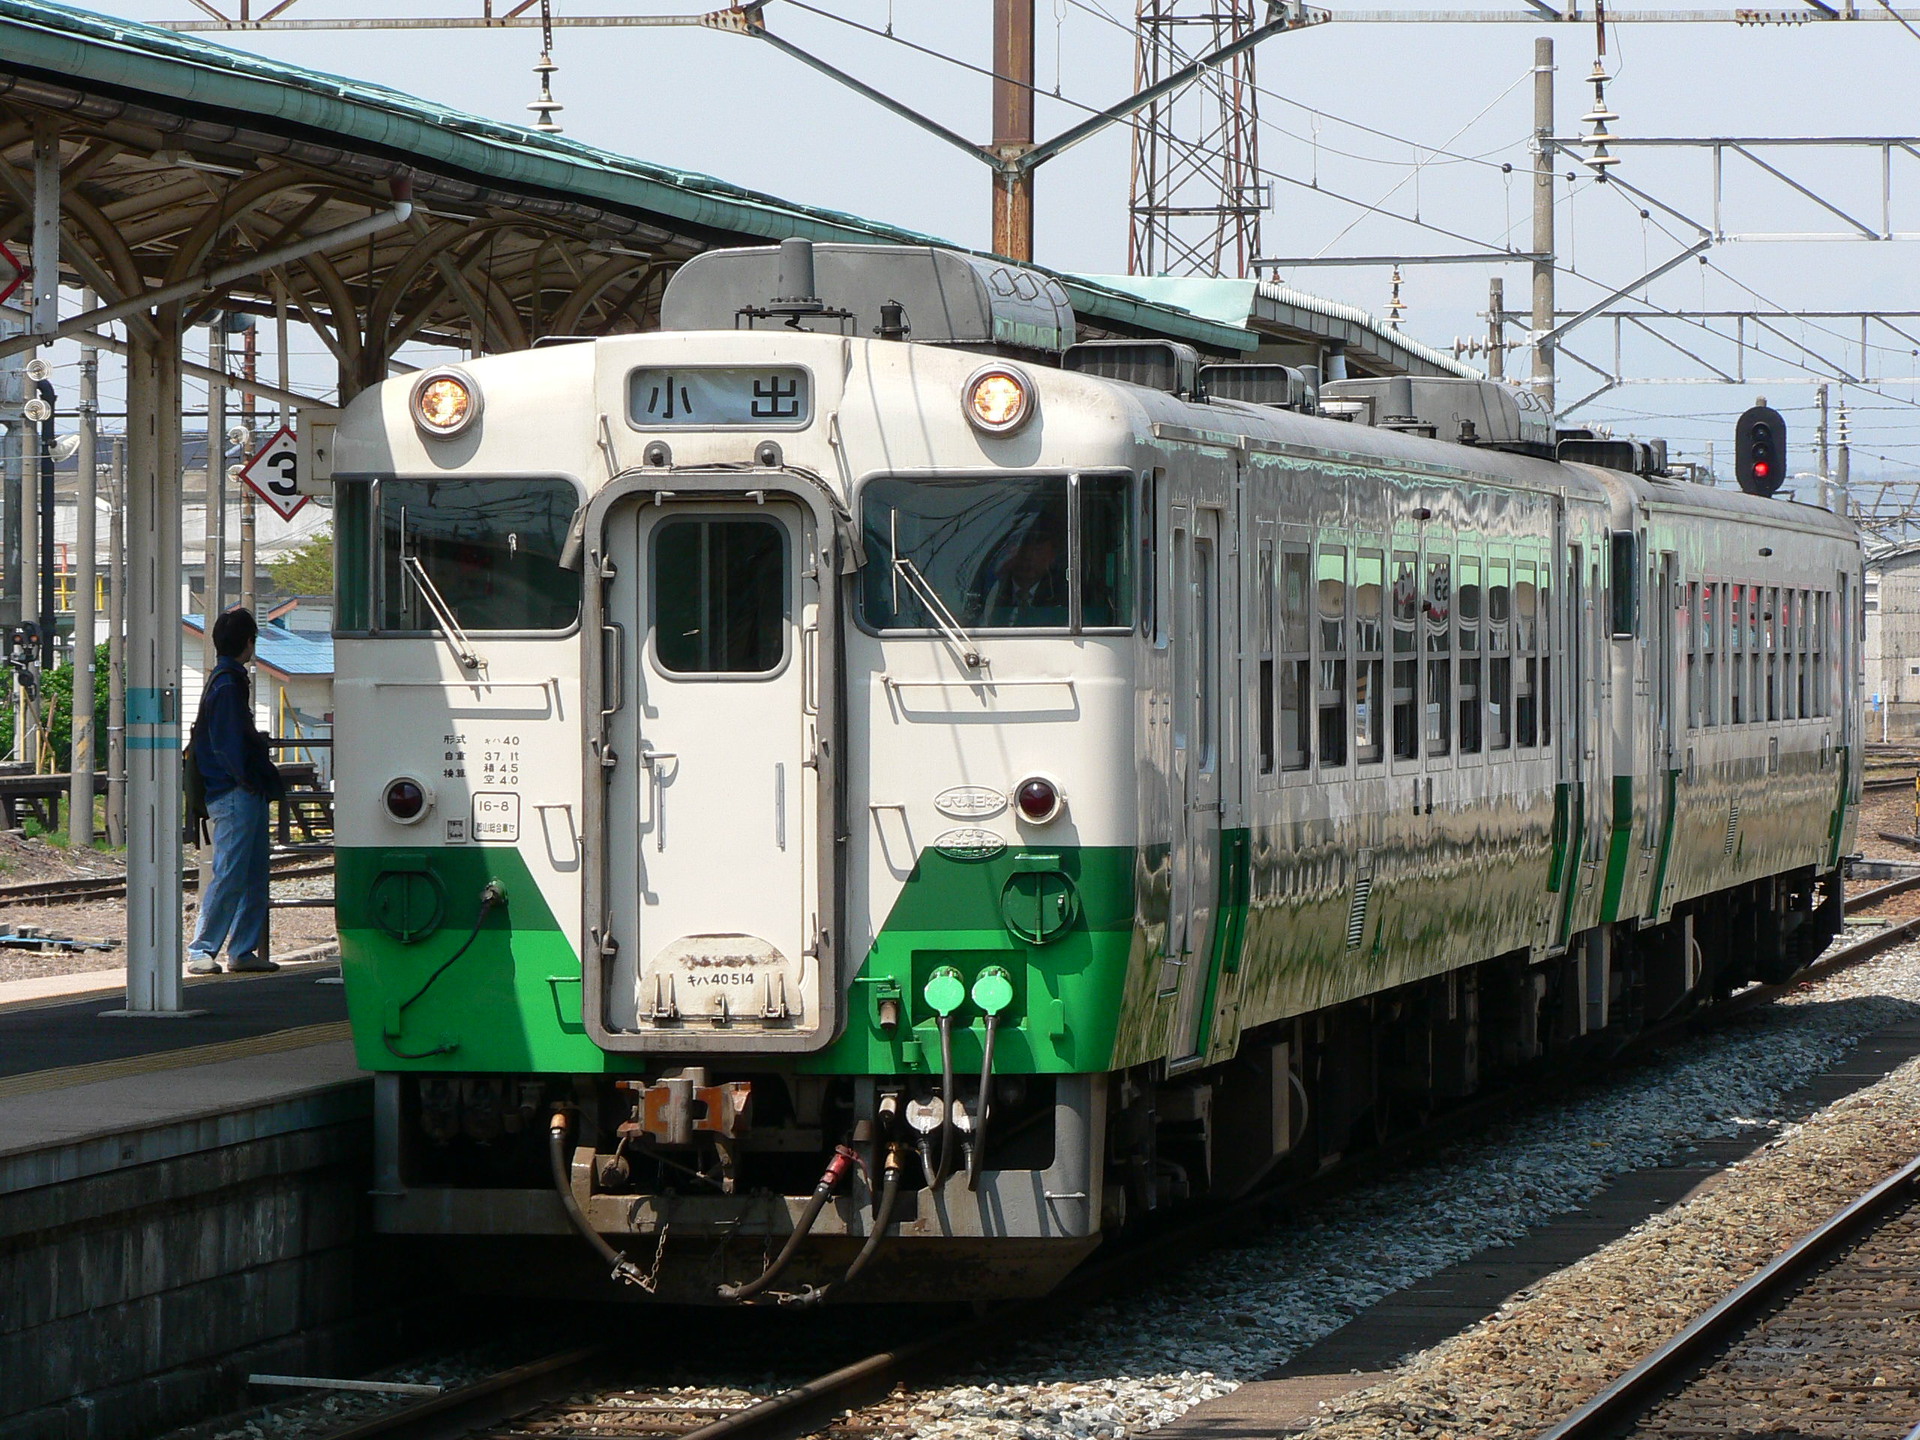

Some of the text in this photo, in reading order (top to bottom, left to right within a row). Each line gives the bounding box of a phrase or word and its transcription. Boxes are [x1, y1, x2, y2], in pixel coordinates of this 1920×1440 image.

[647, 375, 799, 419] 小出
[267, 451, 297, 496] 3
[443, 734, 520, 746] 形式 キハ40
[444, 751, 467, 761] 自重
[499, 763, 519, 773] 4.5
[483, 775, 519, 785] 空 4.0
[479, 800, 510, 812] 16-8
